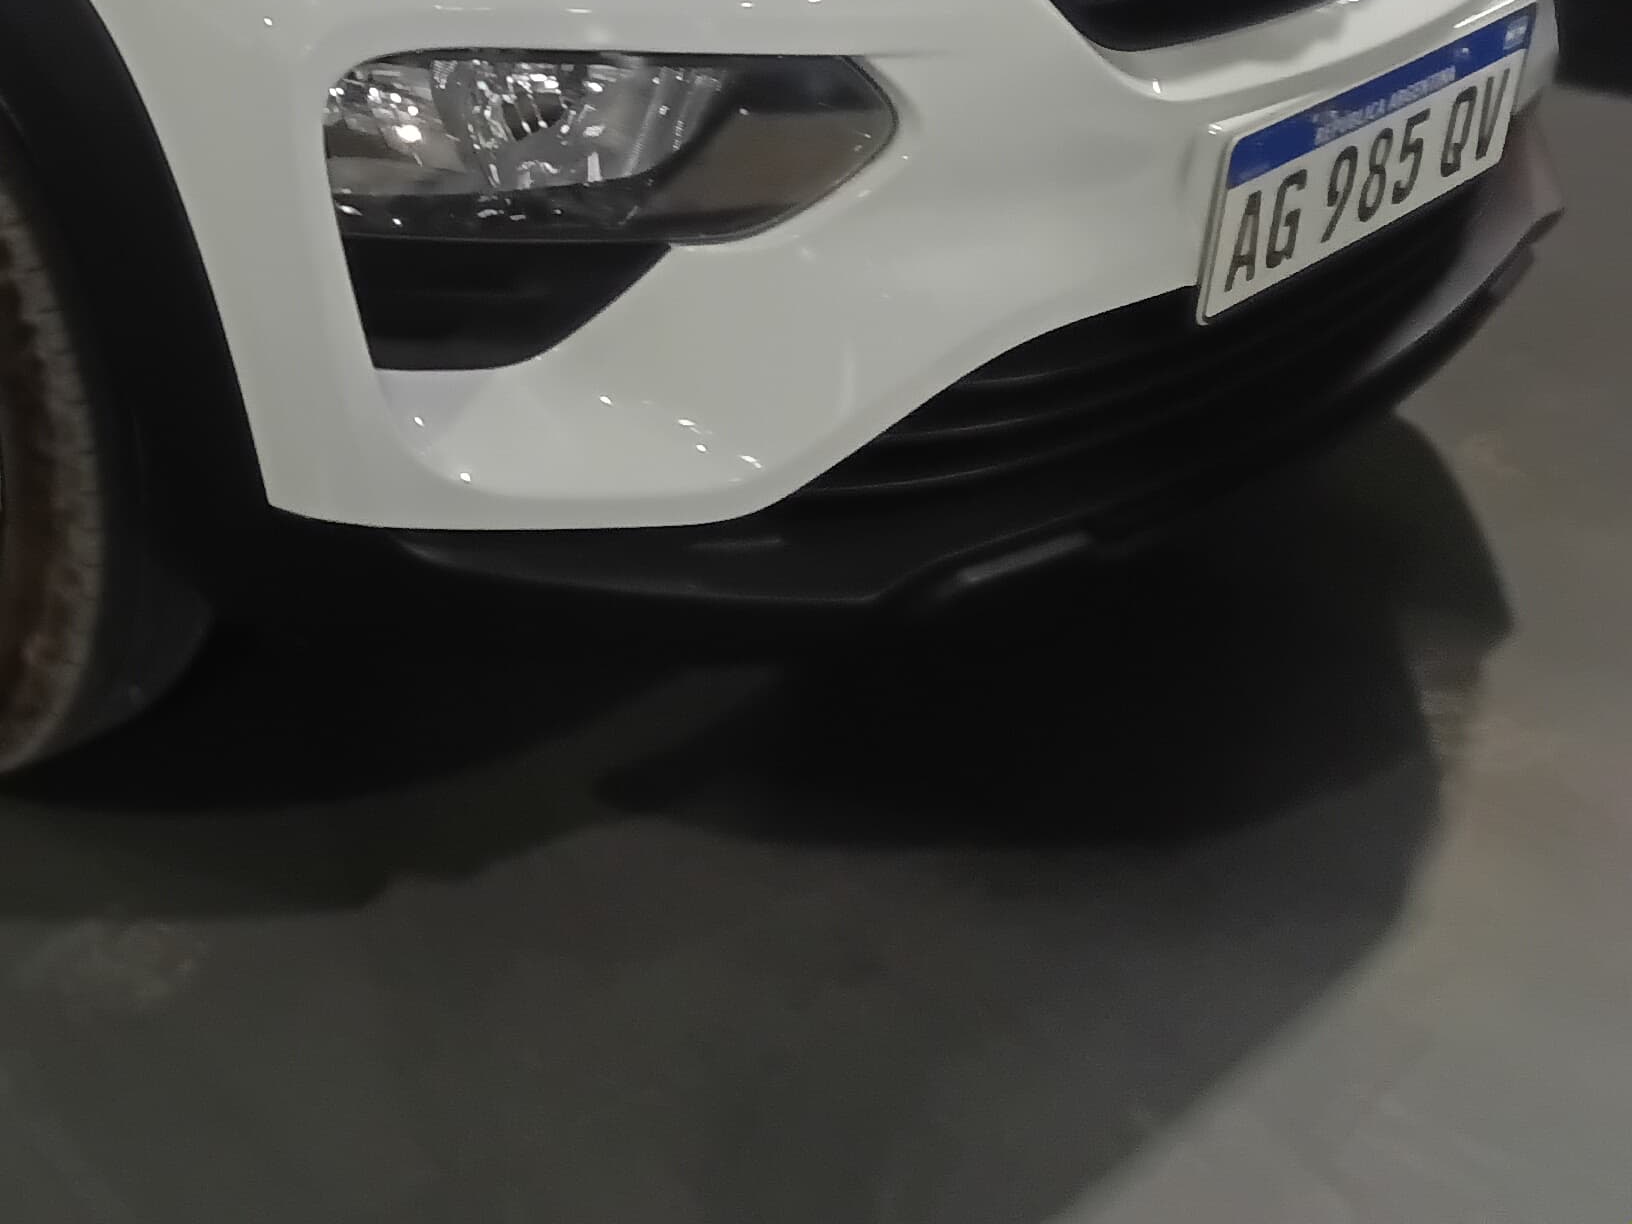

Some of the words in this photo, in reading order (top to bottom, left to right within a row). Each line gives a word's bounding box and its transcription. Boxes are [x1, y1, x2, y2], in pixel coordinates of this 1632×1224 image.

[1224, 169, 1307, 292] AG
[1321, 108, 1431, 243] 985
[1440, 68, 1510, 178] QV
